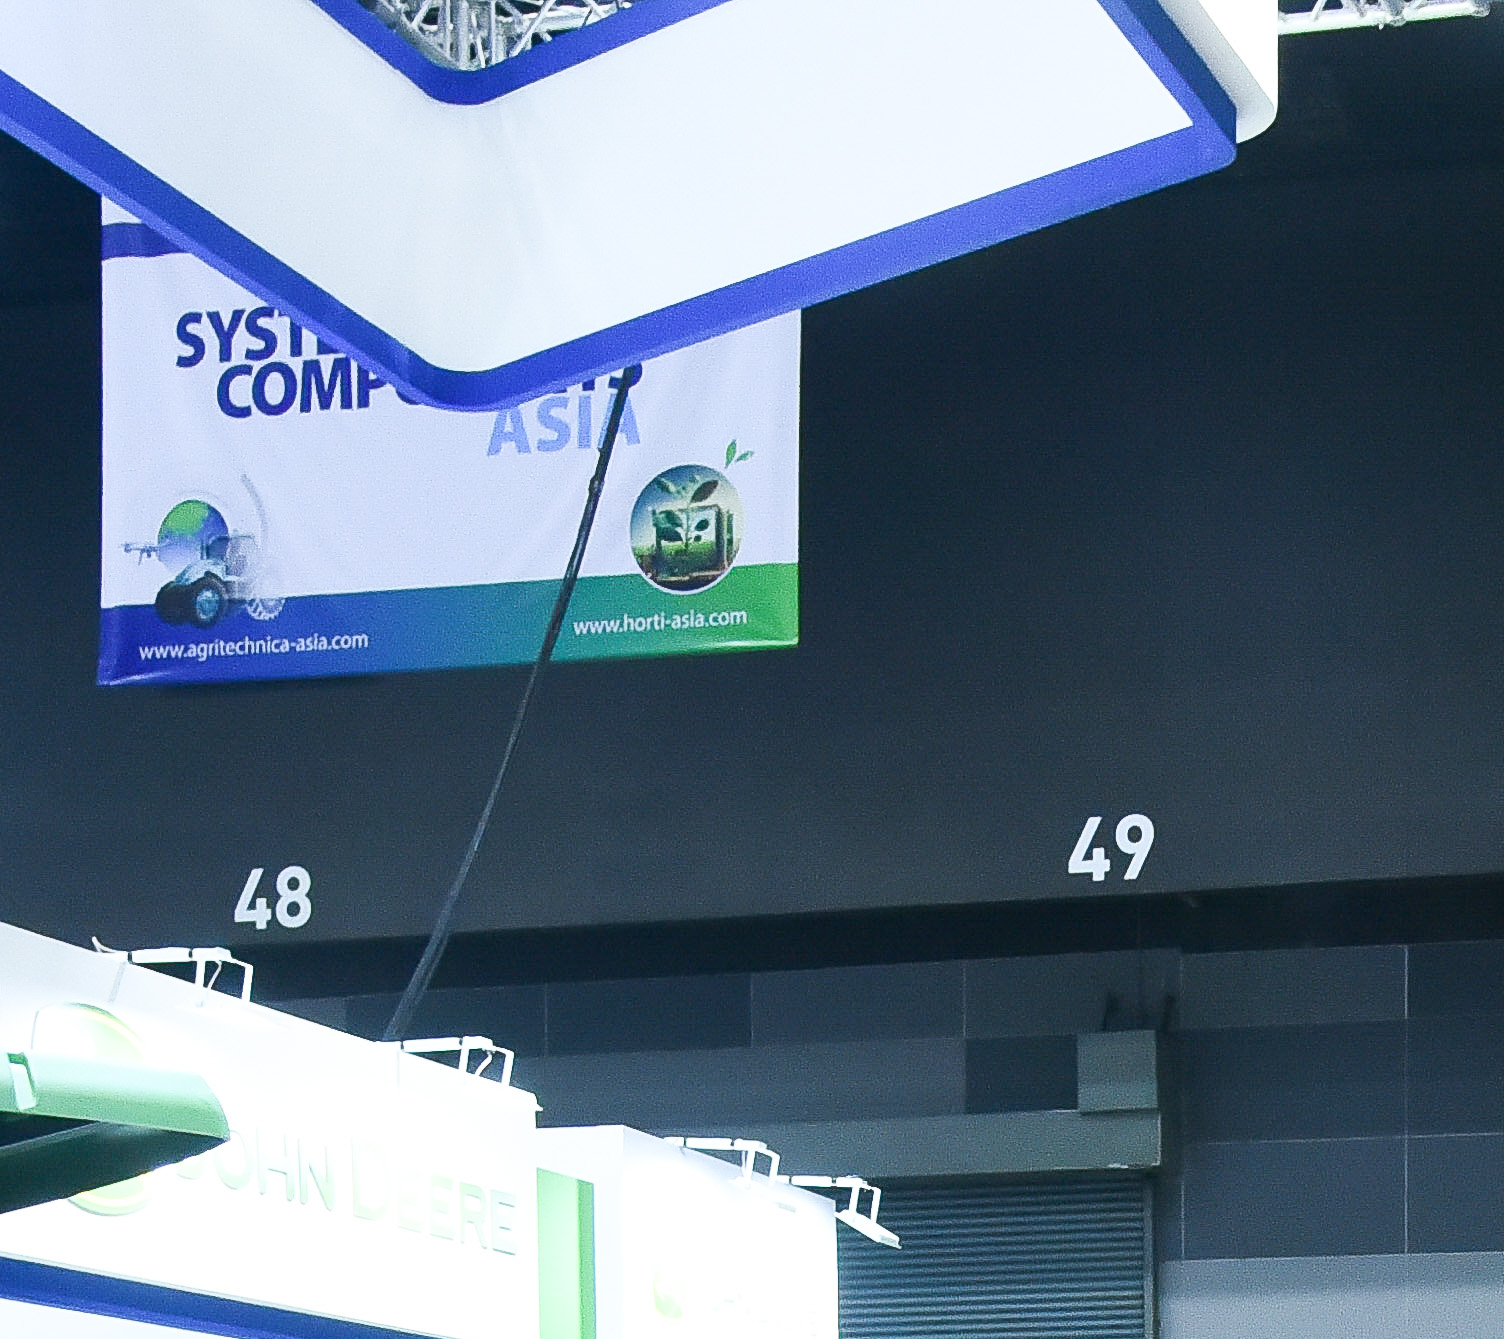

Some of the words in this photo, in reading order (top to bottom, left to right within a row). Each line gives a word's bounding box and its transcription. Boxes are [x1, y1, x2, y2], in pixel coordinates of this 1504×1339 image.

[487, 394, 641, 456] ASIA
[139, 632, 369, 661] www.agritechnica-asia.com
[573, 607, 748, 636] www.horti-asia.com
[1068, 813, 1156, 882] 49
[234, 867, 313, 931] 48
